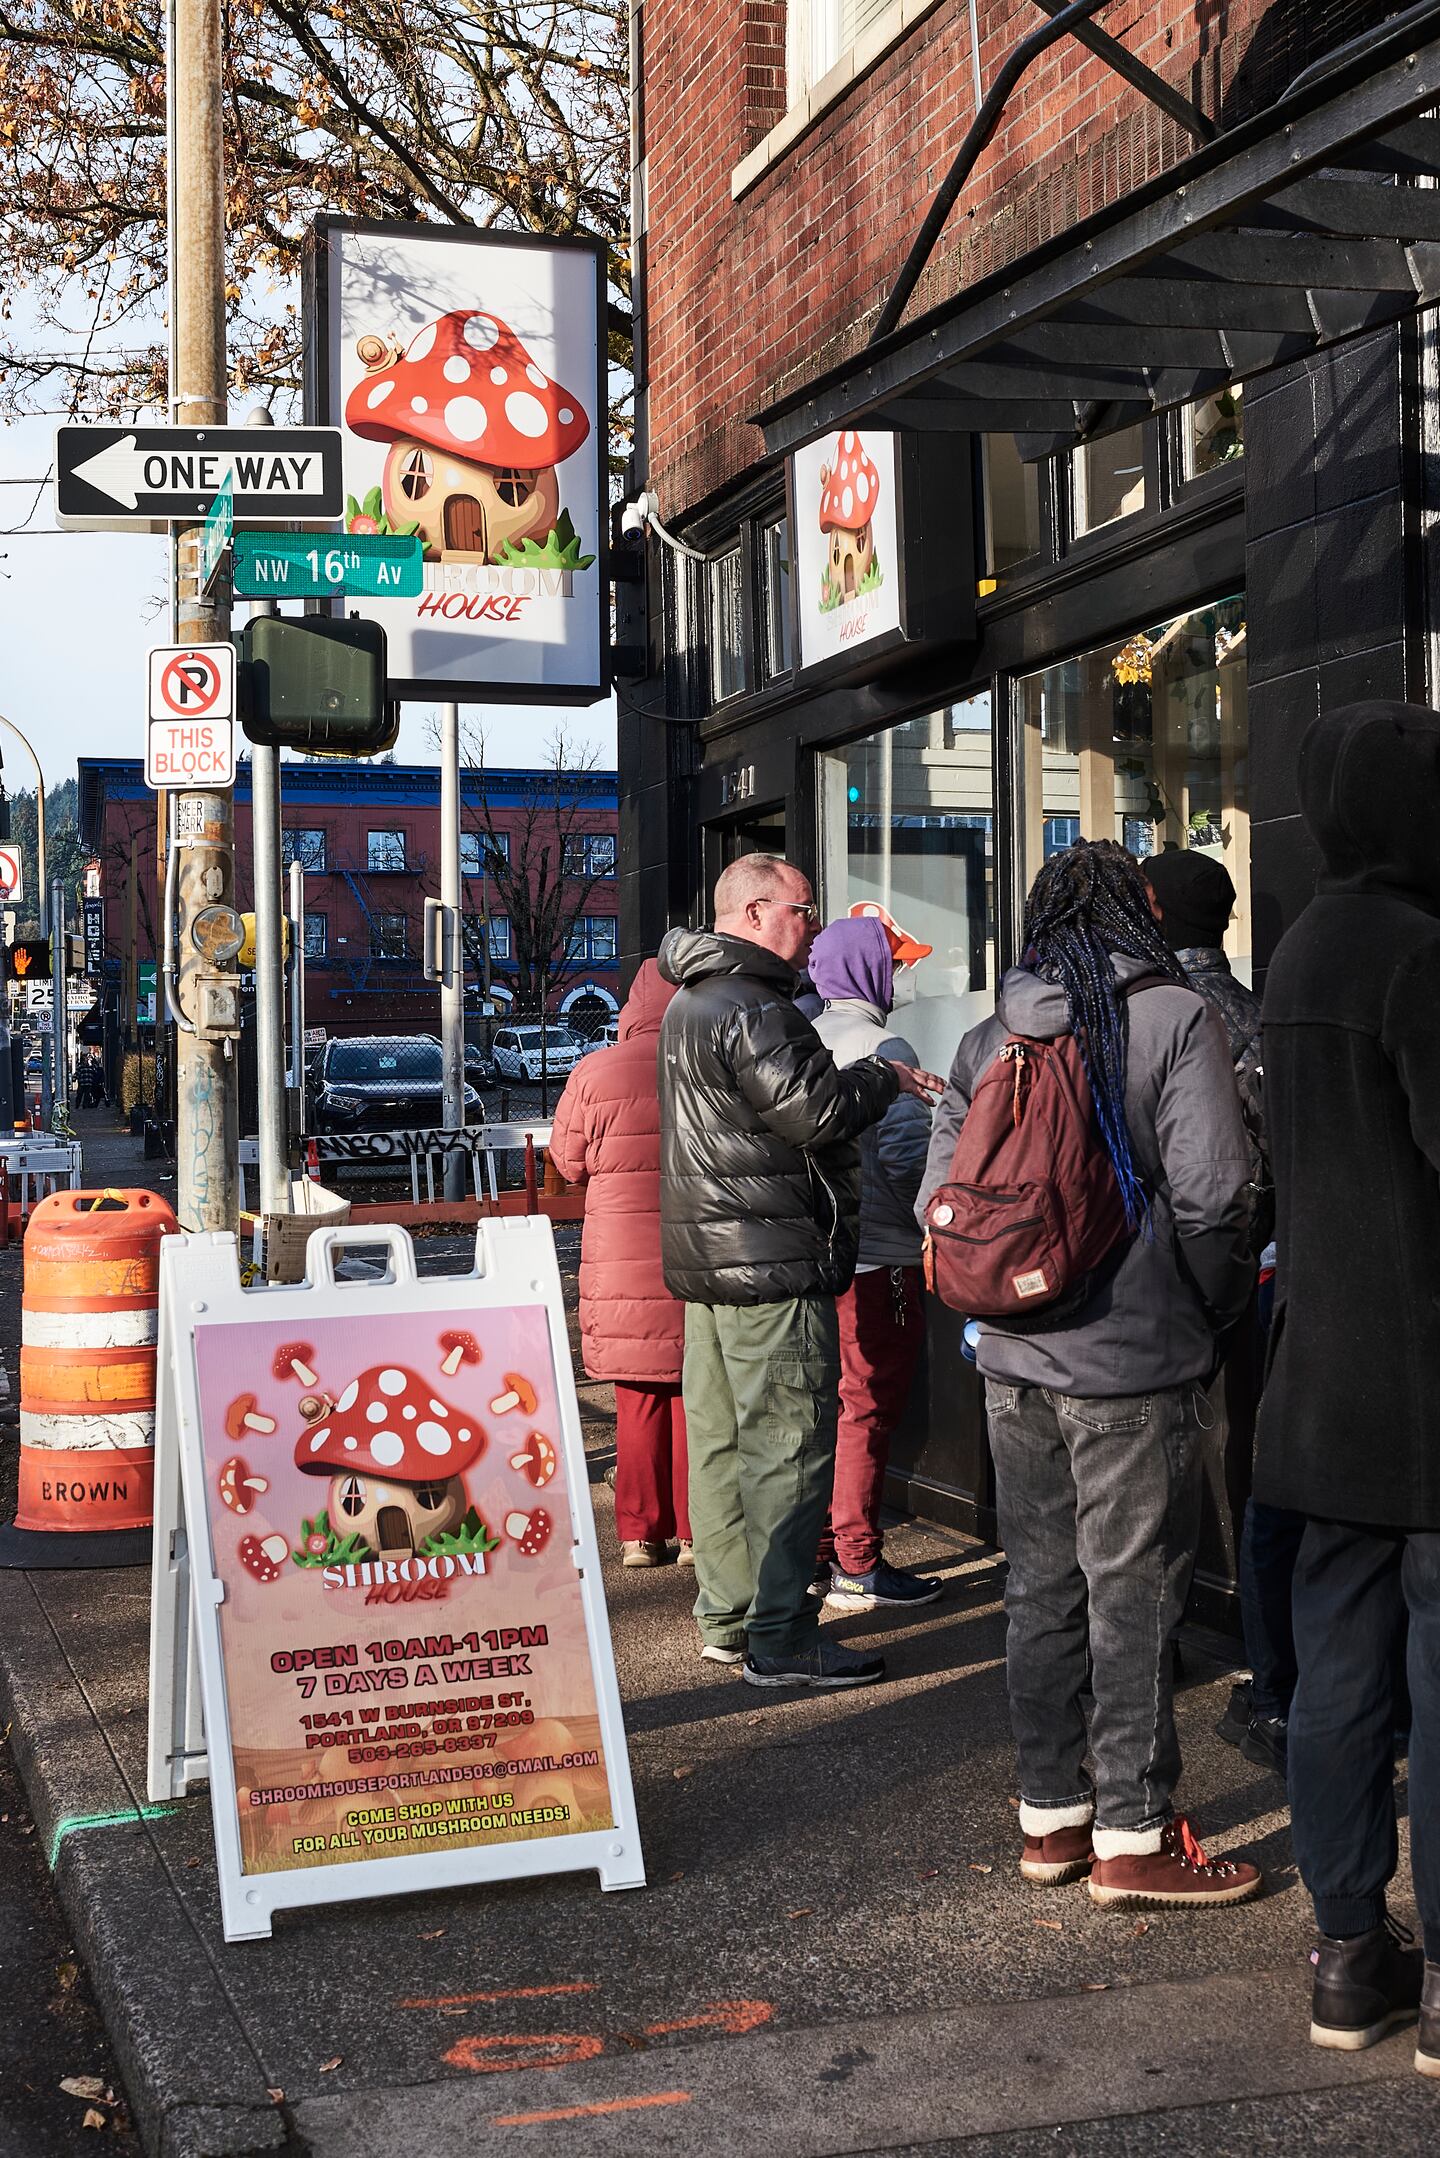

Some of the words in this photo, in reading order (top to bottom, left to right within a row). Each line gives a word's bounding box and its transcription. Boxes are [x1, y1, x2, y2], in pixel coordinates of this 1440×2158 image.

[143, 456, 220, 489] ONE
[235, 457, 312, 490] WAY
[255, 559, 289, 582] NW
[306, 550, 361, 583] 16th
[424, 563, 575, 598] ROOM
[417, 591, 532, 622] HOUSE
[839, 611, 868, 642] HOUSE
[167, 727, 213, 749] THIS
[155, 751, 226, 773] BLOCK
[720, 765, 756, 806] 1541
[31, 988, 54, 1005] 25
[33, 979, 53, 987] LIMI
[42, 1481, 128, 1502] BROWN
[322, 1552, 487, 1590] SHROOM
[838, 1578, 865, 1594] HOKA
[364, 1577, 454, 1606] HOUSE
[270, 1644, 358, 1674] OPEN
[364, 1624, 549, 1664] 10AM-11PM
[296, 1676, 317, 1699] 7
[325, 1667, 409, 1696] DAYS
[414, 1664, 438, 1687] A
[441, 1653, 533, 1683] WEEK
[299, 1710, 354, 1730] 1541
[359, 1707, 380, 1724] W
[384, 1694, 495, 1720] BURNSIDE
[498, 1691, 532, 1708] ST,
[306, 1722, 429, 1749] PORTLAND,
[433, 1718, 462, 1735] OR
[466, 1709, 535, 1731] 97209
[348, 1732, 498, 1764] 503-265-8337
[249, 1751, 599, 1806] SHROOMHOUSEPORTLAND503@GMAIL.COM
[347, 1807, 395, 1827] COME
[398, 1801, 443, 1821] SHOP
[446, 1795, 489, 1815] WITH
[492, 1792, 514, 1808] US
[293, 1835, 327, 1855] FOR
[329, 1831, 361, 1850] ALL
[362, 1825, 408, 1845] YOUR
[410, 1813, 507, 1839] MUSHROOM
[510, 1805, 571, 1827] NEEDS!
